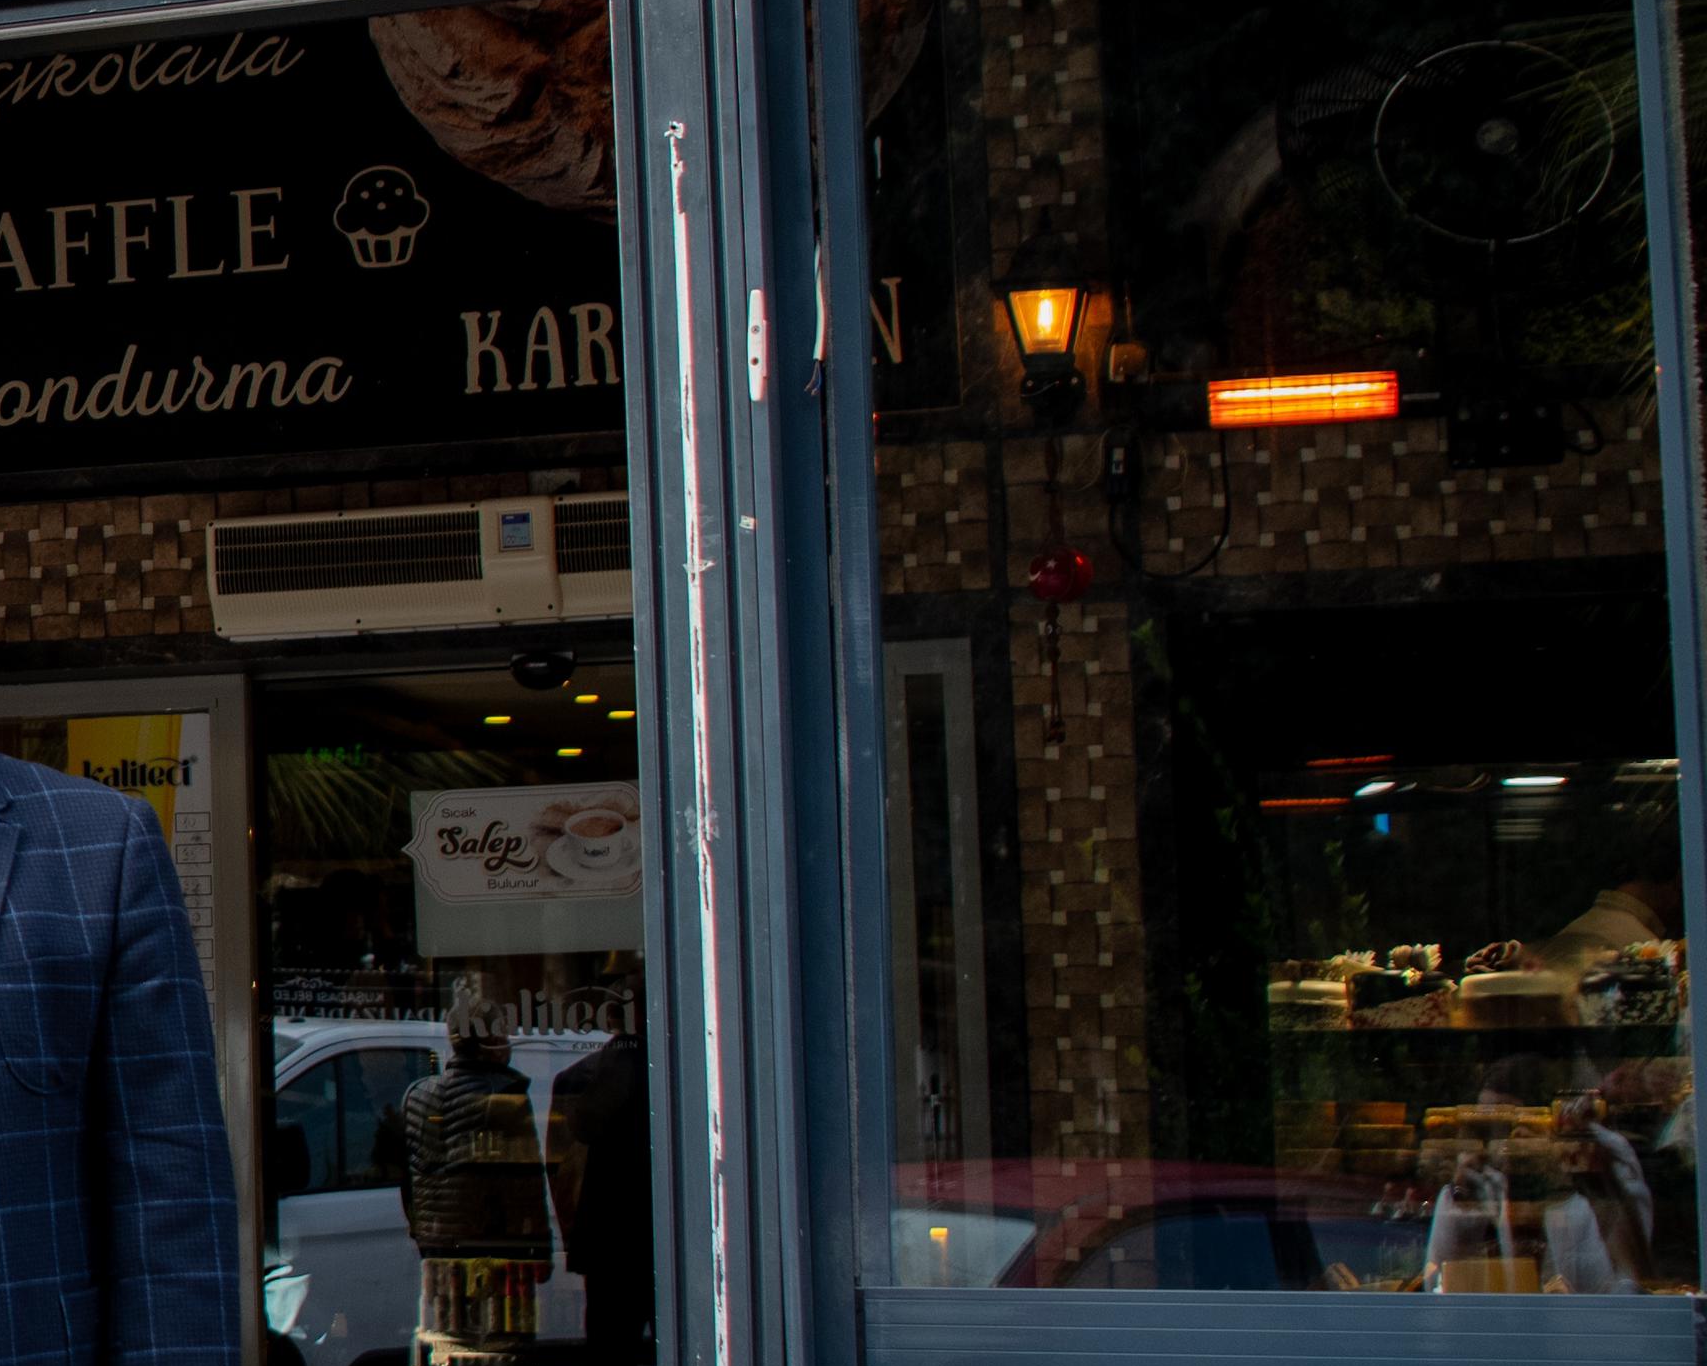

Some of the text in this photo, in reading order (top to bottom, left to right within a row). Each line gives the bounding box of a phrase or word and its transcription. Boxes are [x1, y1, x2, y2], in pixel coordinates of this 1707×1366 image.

[83, 756, 190, 790] kaliteci
[441, 806, 477, 819] Sıcak
[438, 821, 535, 872] Salep
[487, 878, 540, 890] Bulunur
